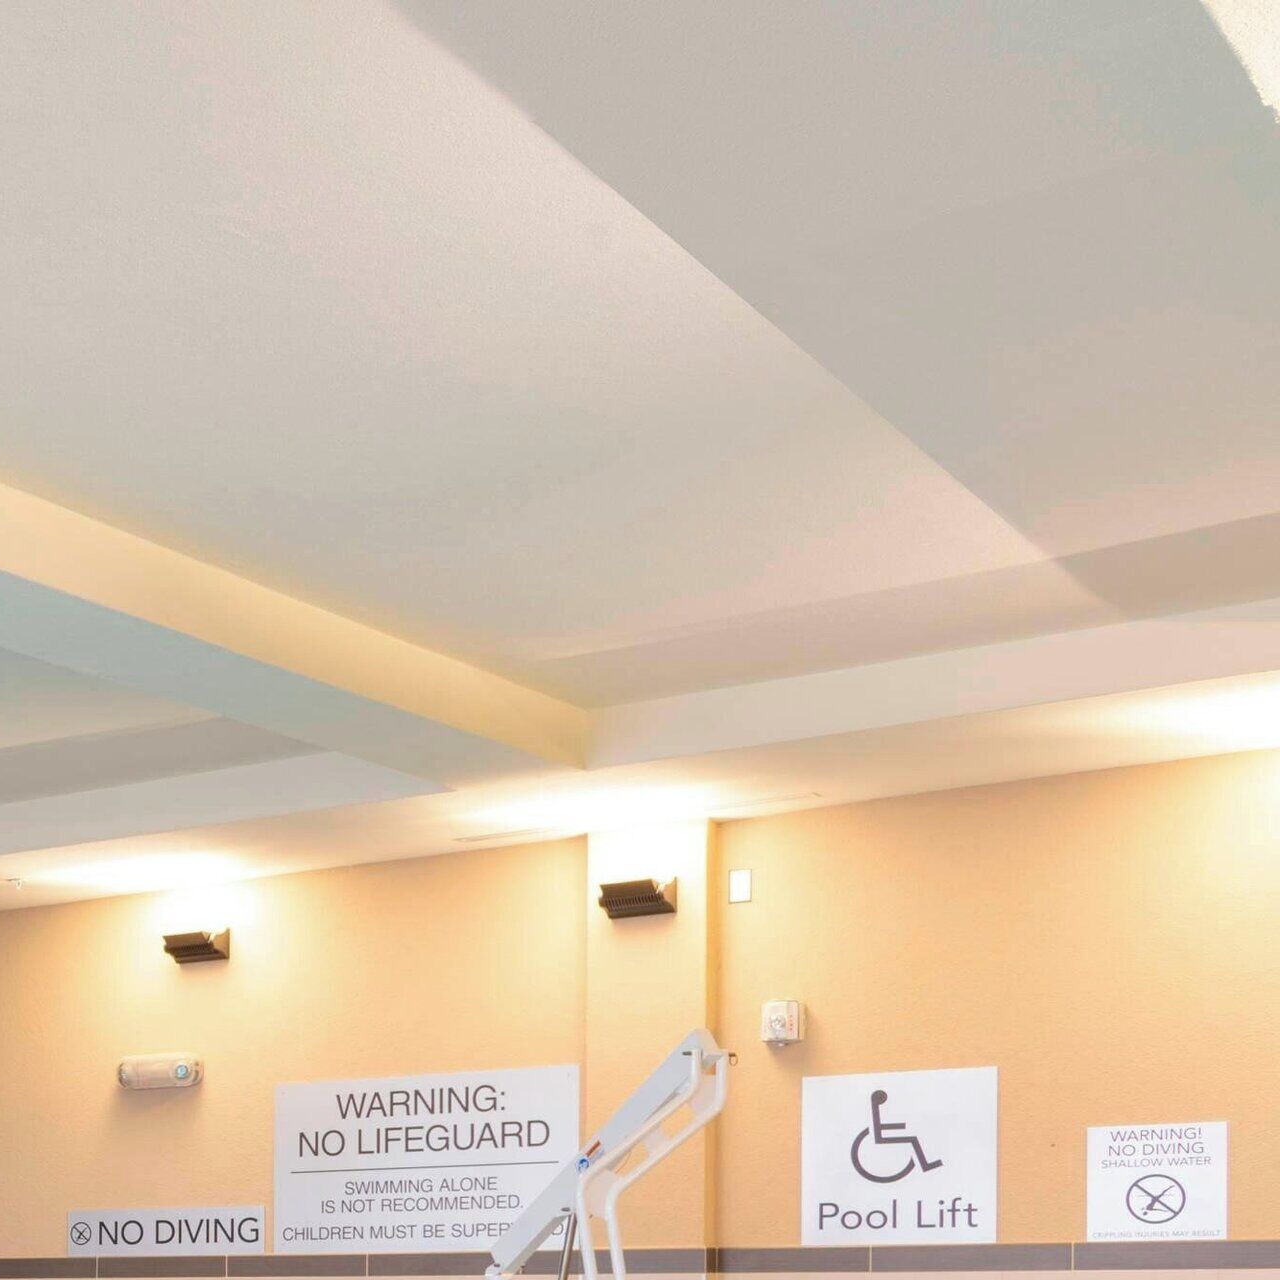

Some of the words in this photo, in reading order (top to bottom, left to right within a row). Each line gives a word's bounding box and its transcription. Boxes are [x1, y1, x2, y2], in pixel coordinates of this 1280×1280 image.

[336, 1084, 507, 1120] WARNING:
[298, 1130, 345, 1158] NO
[358, 1119, 551, 1155] LIFEGUARD
[1110, 1127, 1203, 1142] WARNING!
[1108, 1144, 1136, 1157] NO
[1142, 1141, 1204, 1156] DIVING
[1101, 1158, 1163, 1169] SHALLOW
[1167, 1156, 1212, 1167] WATER
[344, 1179, 433, 1195] SWIMMING
[440, 1176, 498, 1192] ALONE
[321, 1200, 336, 1214] IS
[341, 1199, 375, 1214] NOT
[381, 1194, 524, 1212] RECOMMENDED.
[818, 1199, 898, 1231] Pool
[916, 1196, 979, 1230] Lift
[98, 1219, 144, 1246] NO
[155, 1216, 261, 1244] DIVING
[282, 1226, 364, 1241] CHILDREN
[370, 1224, 417, 1240] MUST
[423, 1224, 446, 1238] BE
